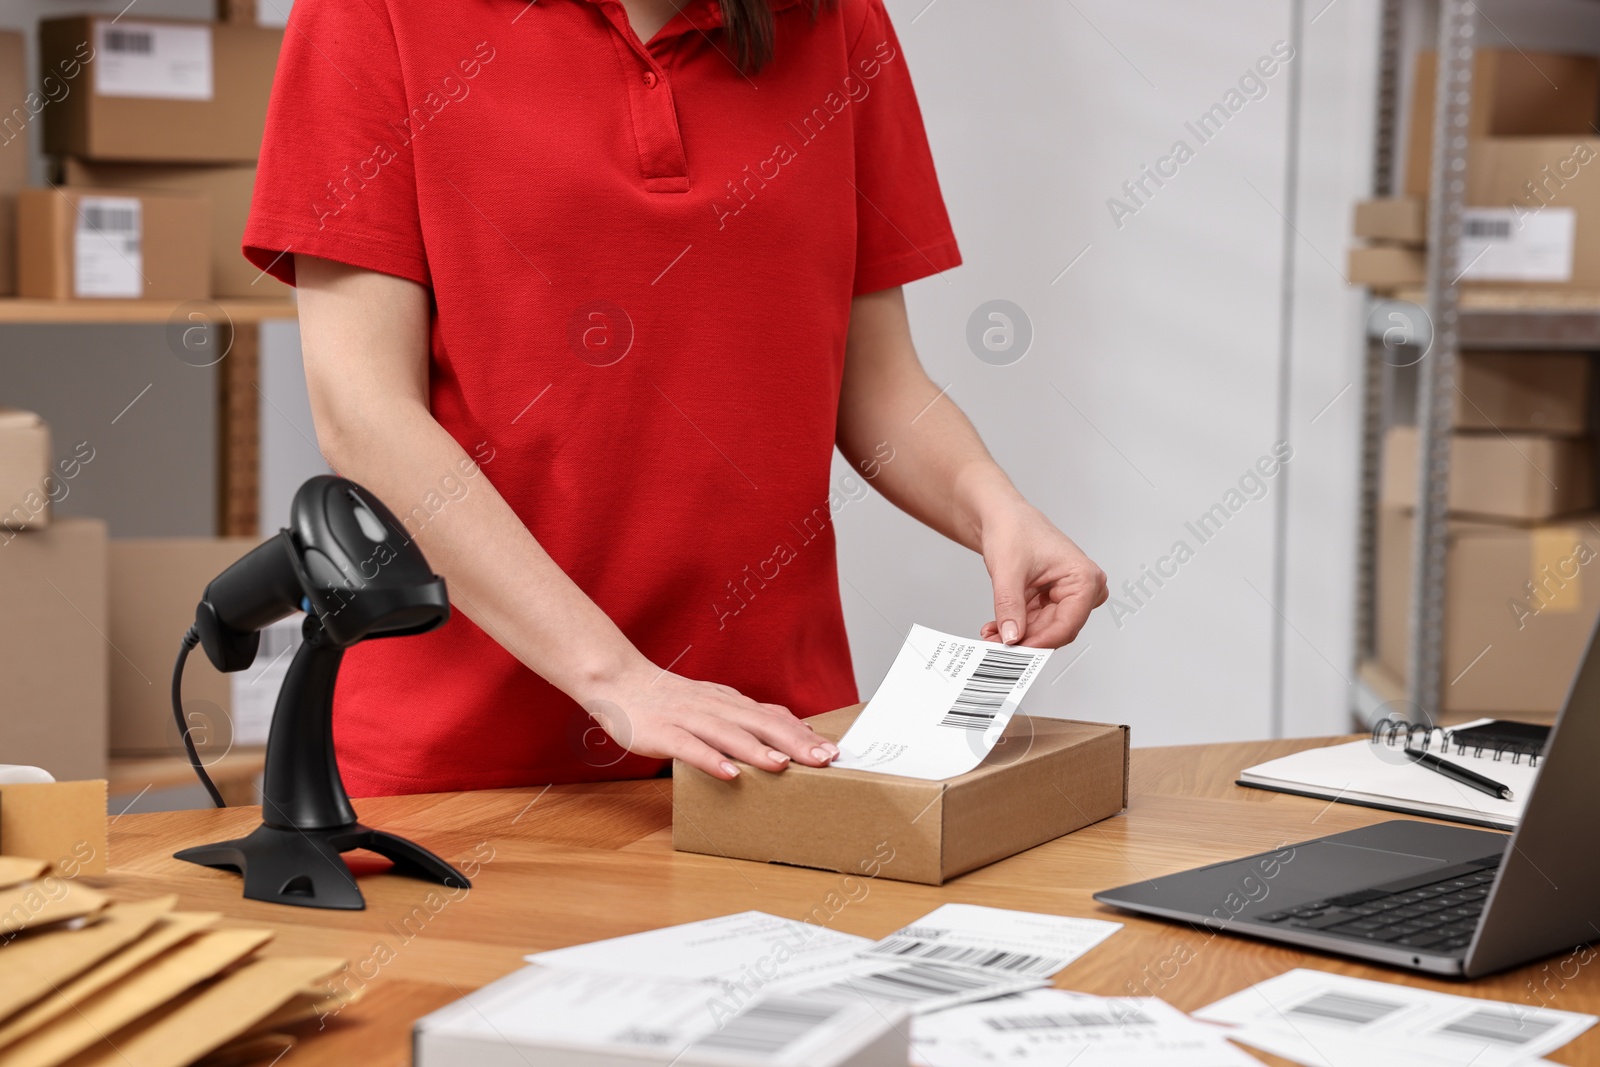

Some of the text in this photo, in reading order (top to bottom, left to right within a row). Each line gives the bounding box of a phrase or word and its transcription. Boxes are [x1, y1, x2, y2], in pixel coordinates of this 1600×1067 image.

[946, 642, 958, 655] CITY
[953, 644, 966, 658] YOUR
[949, 645, 976, 678] SENT FROM
